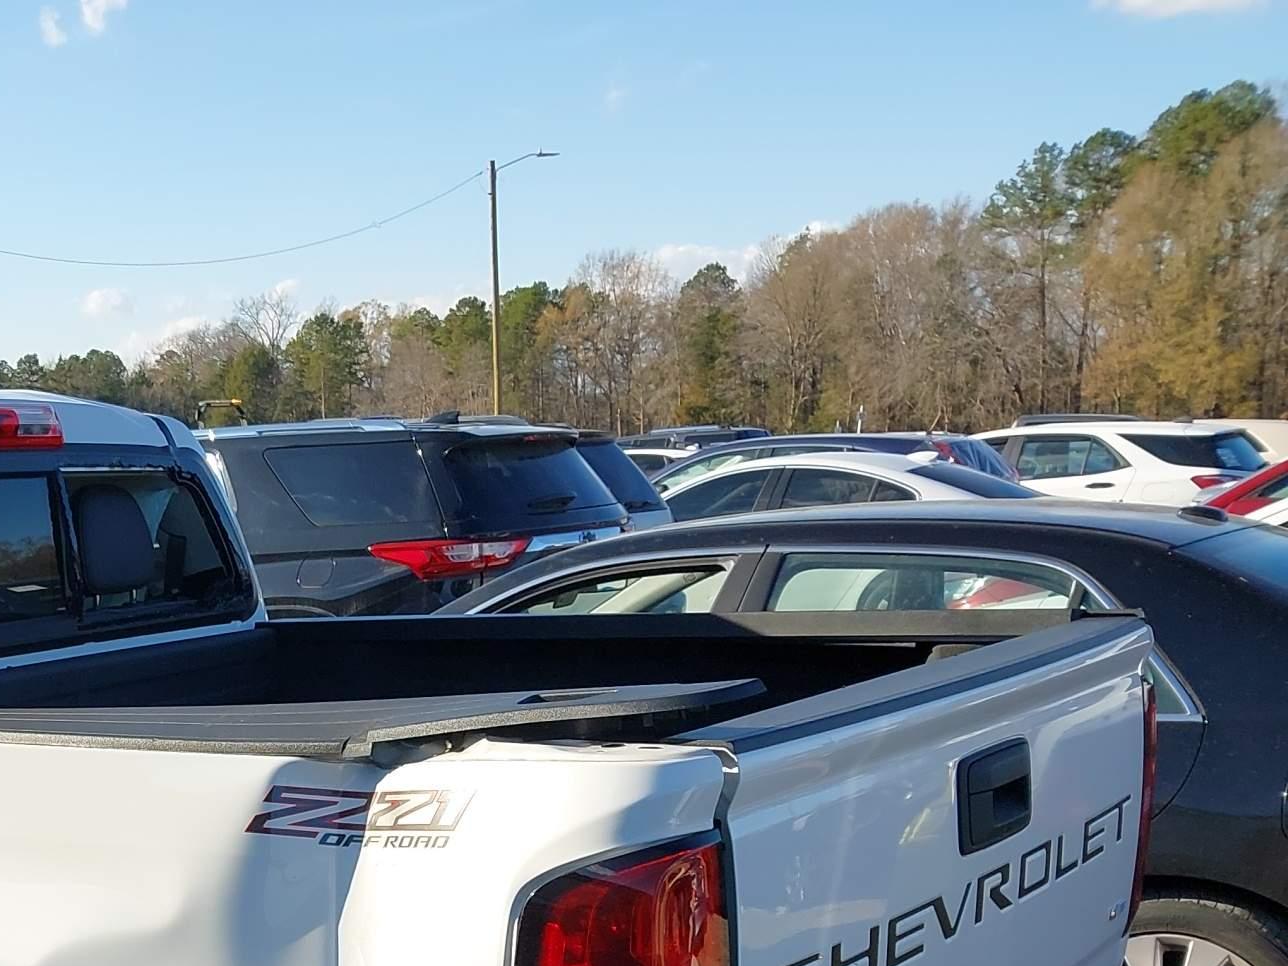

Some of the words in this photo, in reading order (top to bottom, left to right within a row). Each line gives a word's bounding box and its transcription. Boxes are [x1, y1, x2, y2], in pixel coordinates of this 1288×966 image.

[244, 784, 476, 838] Z71
[318, 833, 381, 848] OFF
[383, 835, 450, 849] ROAD
